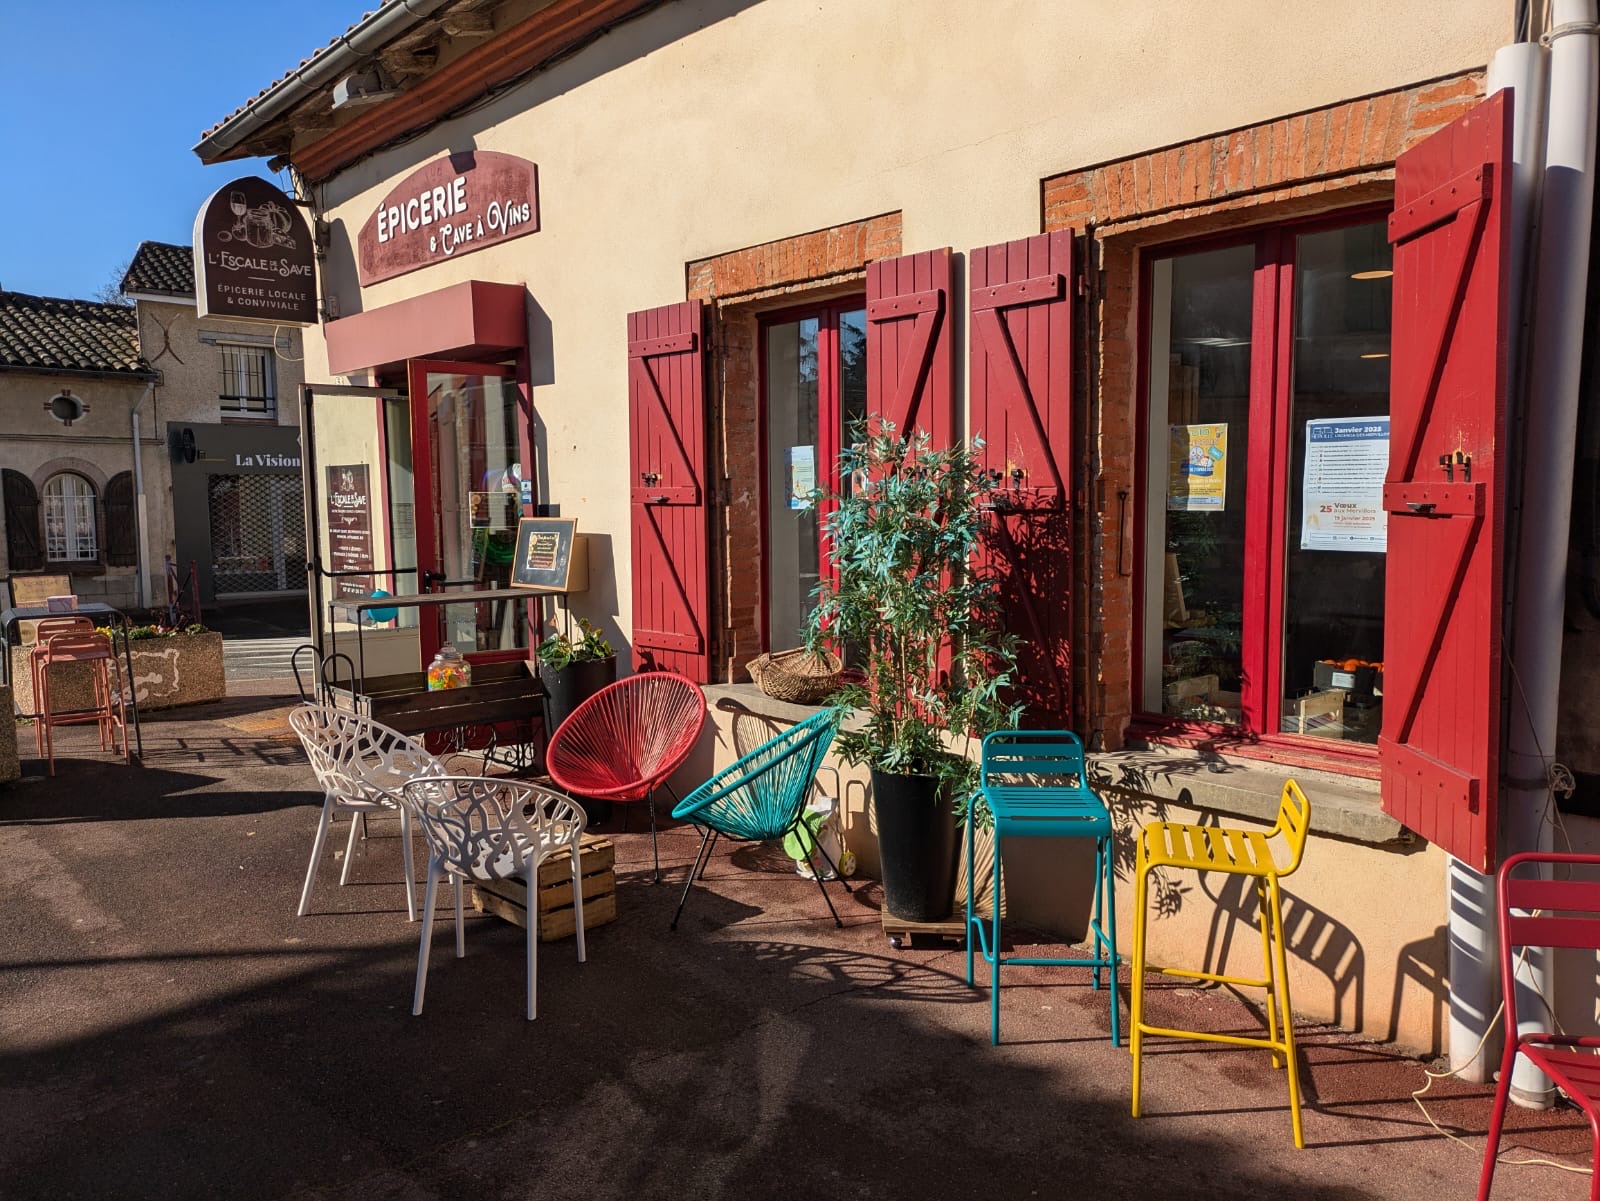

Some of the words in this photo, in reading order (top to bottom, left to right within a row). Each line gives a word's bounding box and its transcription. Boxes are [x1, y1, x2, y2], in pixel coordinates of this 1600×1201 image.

[377, 176, 468, 243] ÉPICERIE
[430, 236, 437, 252] &
[440, 223, 473, 254] CAVE
[476, 215, 485, 237] À
[487, 200, 531, 234] VINS
[208, 251, 269, 271] L'ESCALE
[279, 258, 312, 277] SAVE
[268, 290, 307, 301] LOCALE
[238, 297, 299, 310] CONVIVIALE
[235, 454, 253, 466] La
[1320, 505, 1333, 513] 25
